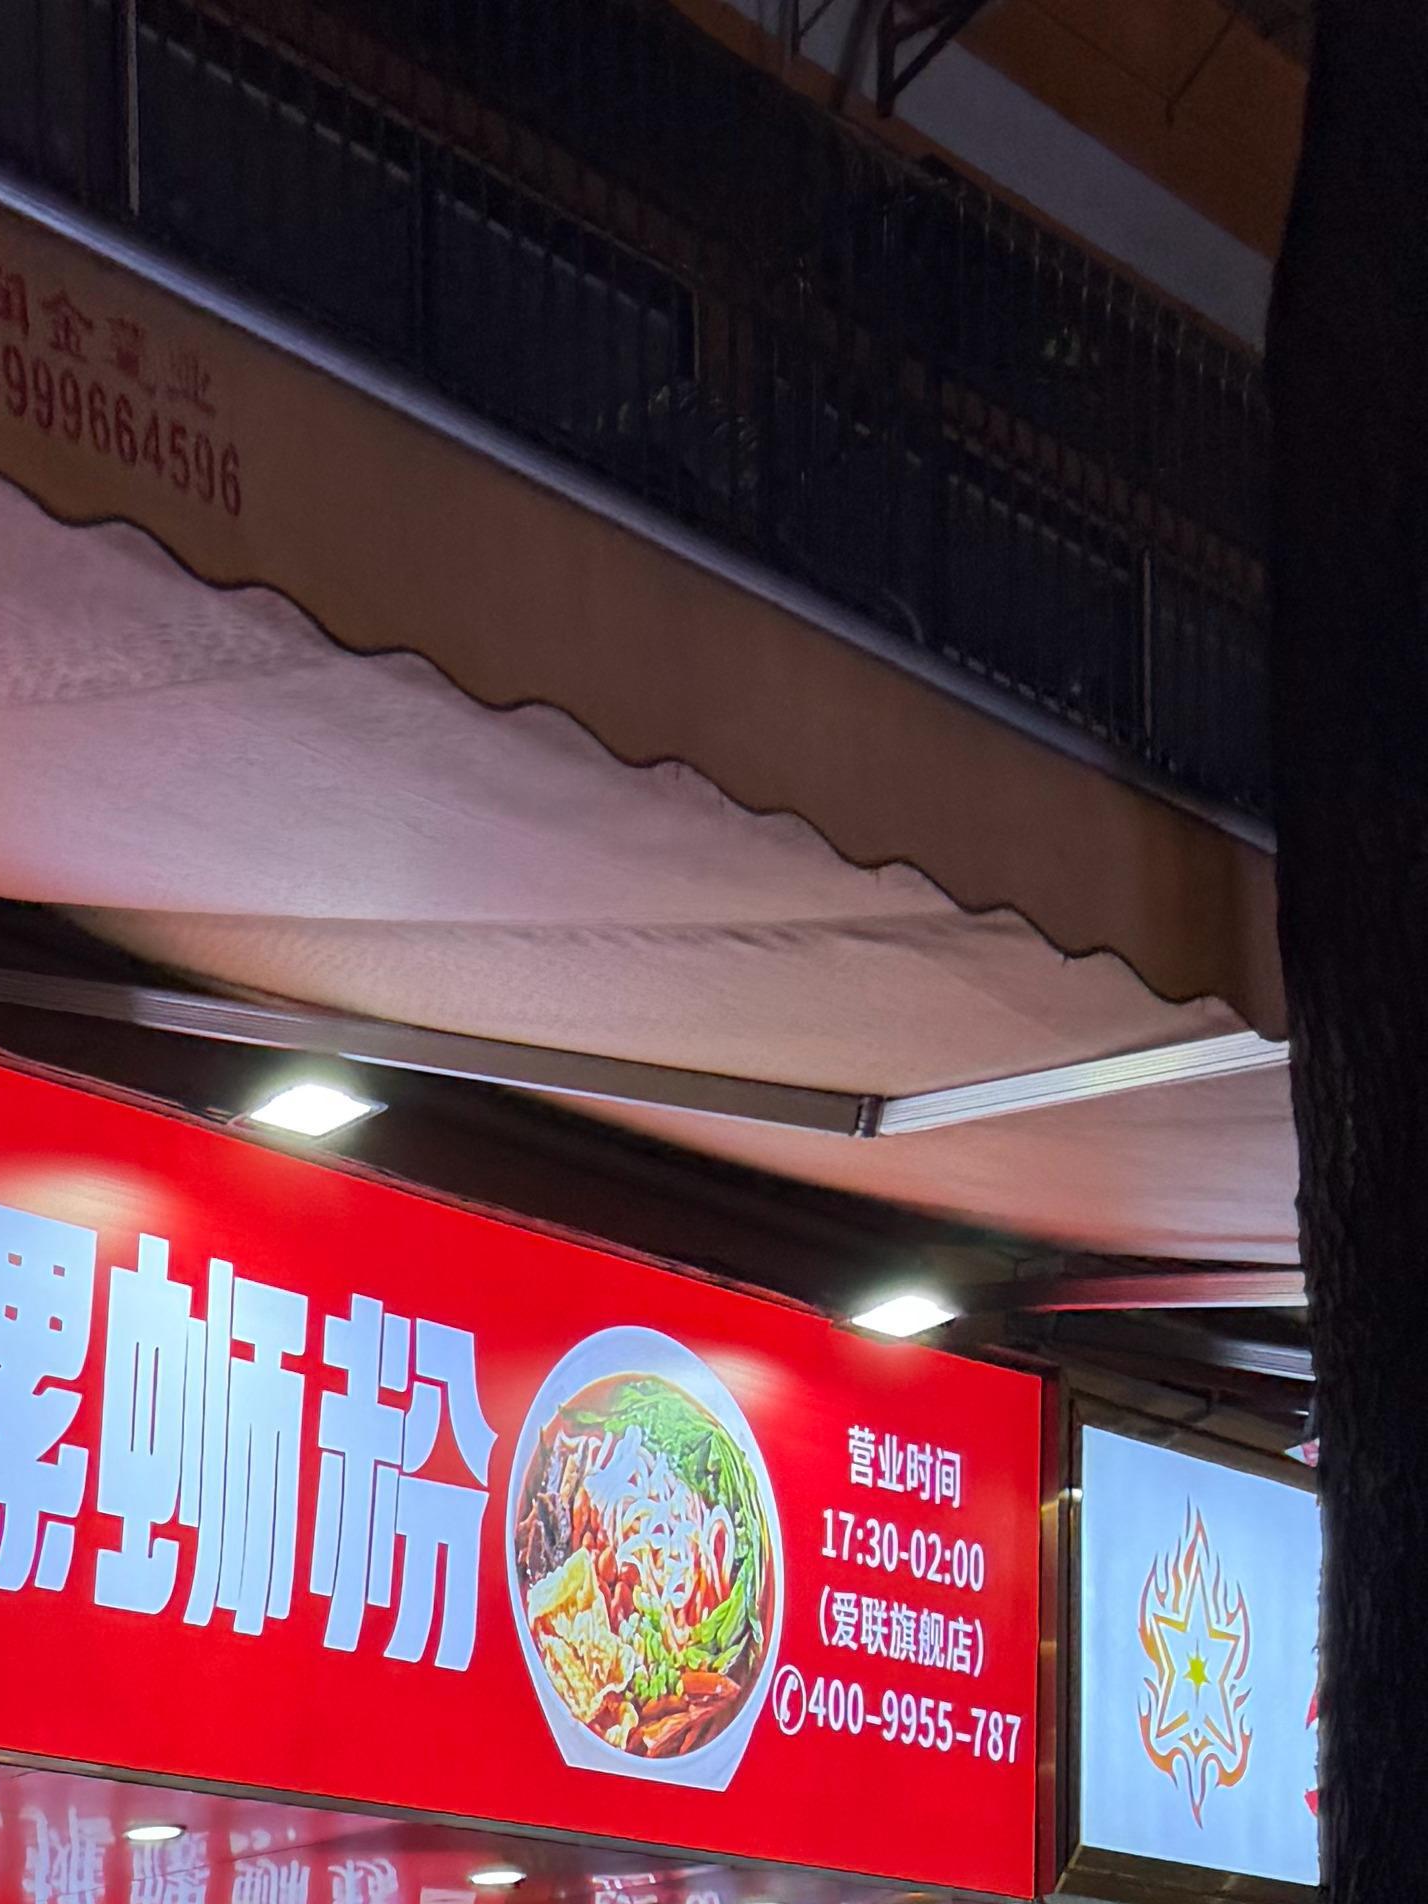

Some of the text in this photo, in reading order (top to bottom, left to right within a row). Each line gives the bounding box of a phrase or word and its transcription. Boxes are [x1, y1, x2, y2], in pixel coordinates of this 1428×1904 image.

[848, 1425, 962, 1510] 营业时间
[821, 1508, 987, 1594] 17:30-02:00
[807, 1681, 1022, 1767] 400-9955-787
